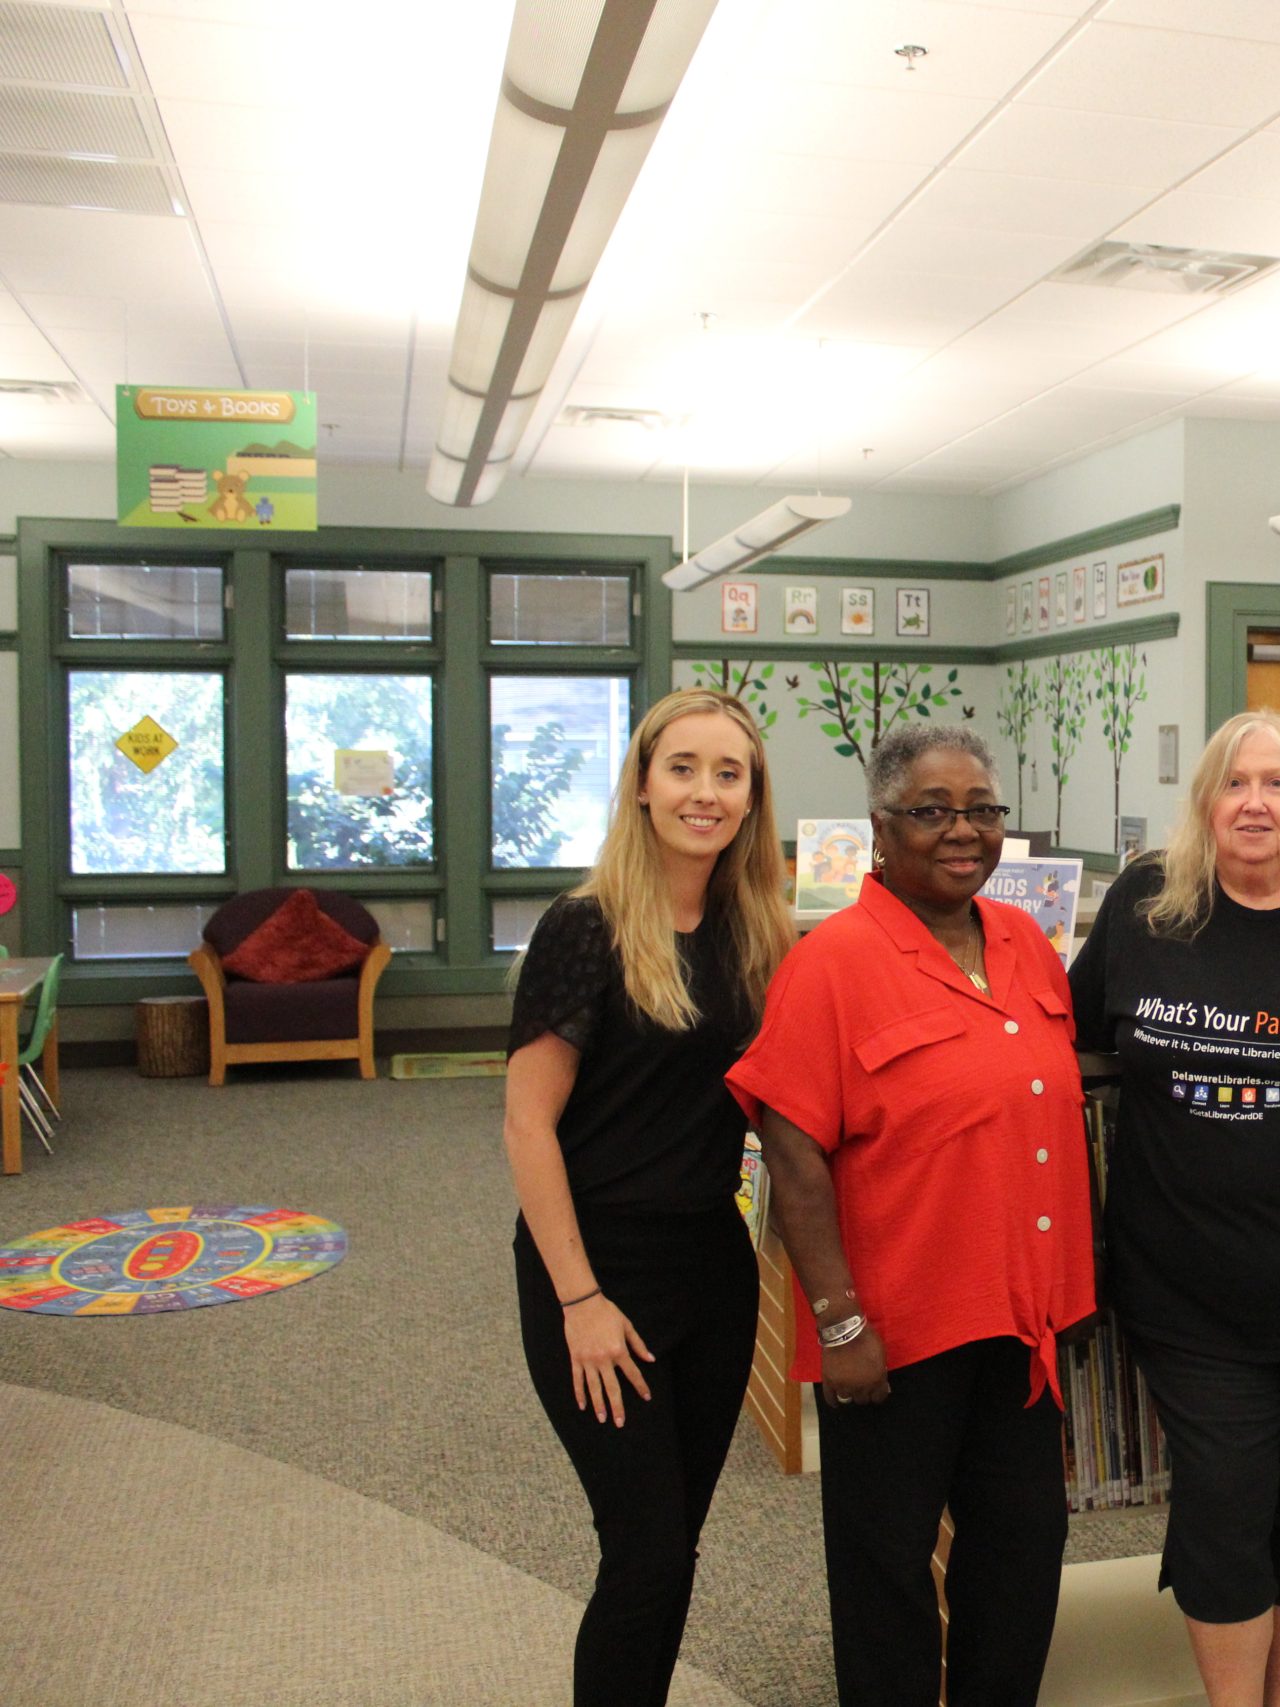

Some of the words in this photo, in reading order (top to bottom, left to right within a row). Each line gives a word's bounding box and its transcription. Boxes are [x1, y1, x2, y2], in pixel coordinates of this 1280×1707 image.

[728, 587, 750, 606] Qq
[791, 589, 812, 604] Rr
[849, 593, 868, 607] Ss
[903, 594, 921, 608] Tt
[984, 878, 1028, 897] KIDS
[1135, 998, 1198, 1026] What's
[1203, 1004, 1250, 1033] Your
[1133, 1028, 1170, 1048] Whatever
[1171, 1039, 1179, 1048] it
[1180, 1040, 1190, 1052] is,
[1192, 1042, 1240, 1055] Delaware
